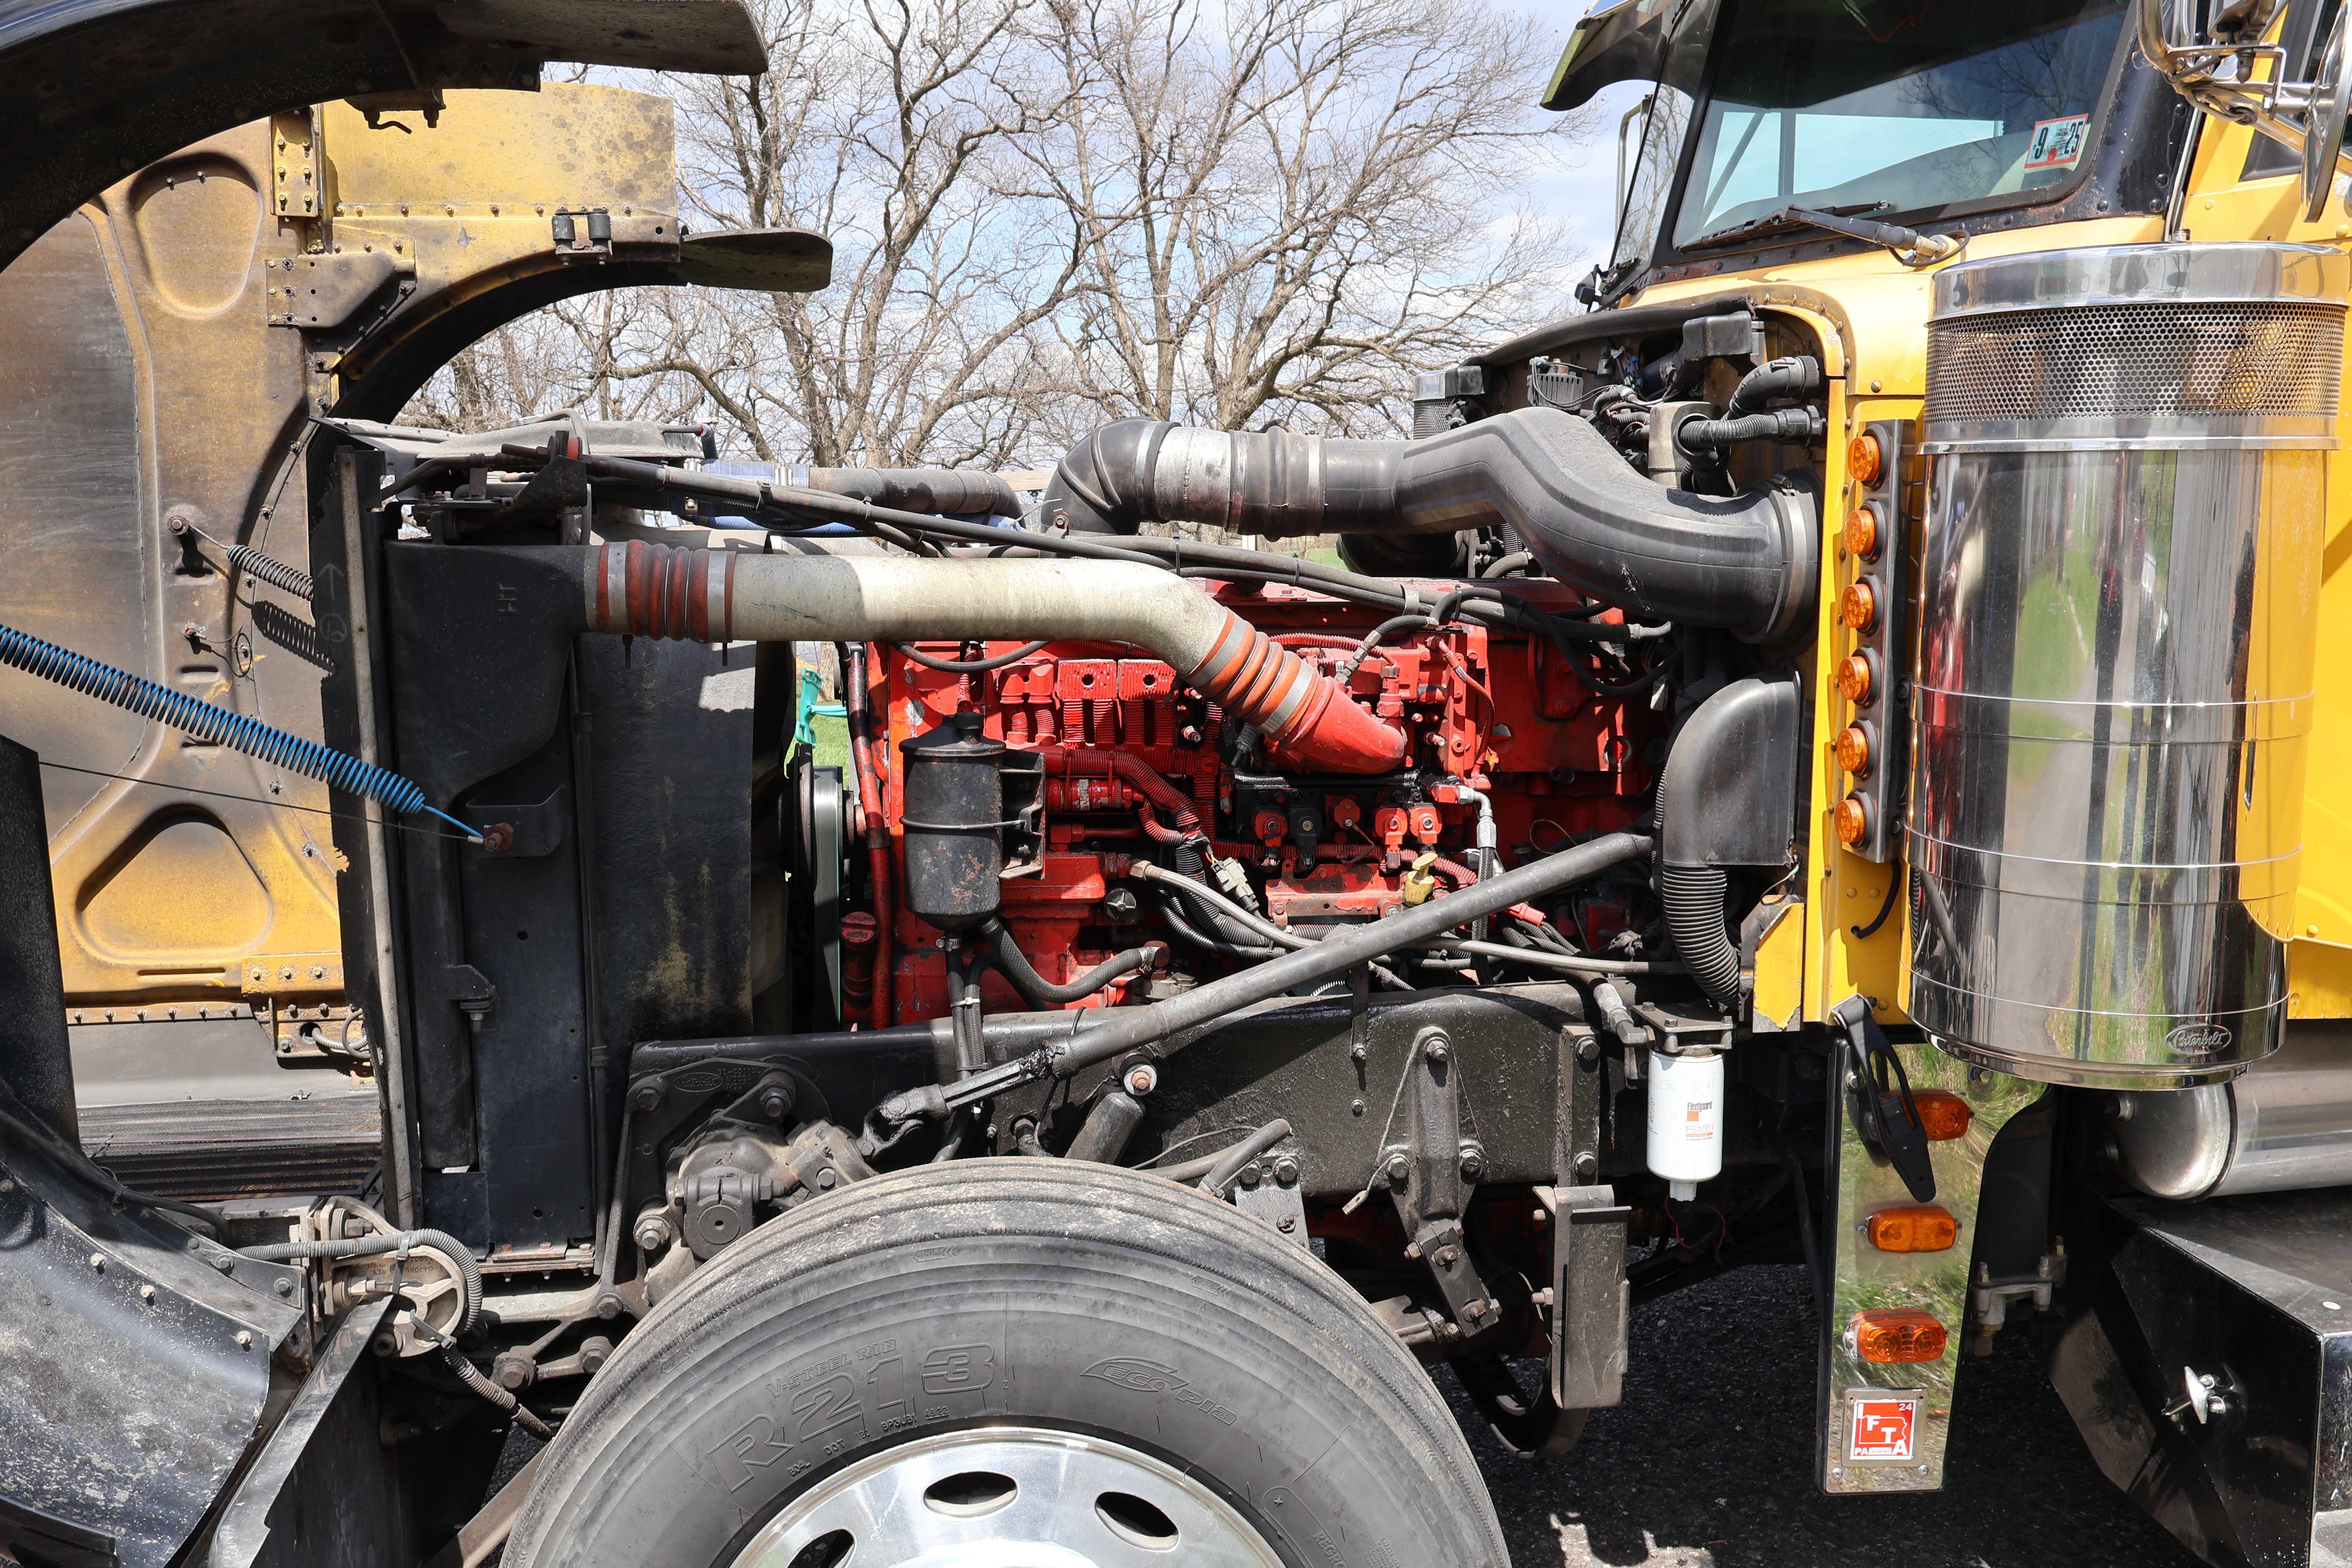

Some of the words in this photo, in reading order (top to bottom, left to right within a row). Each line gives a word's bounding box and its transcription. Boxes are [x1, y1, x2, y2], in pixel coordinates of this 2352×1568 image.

[2034, 127, 2049, 159] 9
[2063, 121, 2084, 154] 25
[1688, 1101, 1712, 1112] Fleetguard
[1686, 1123, 1714, 1134] FS1001
[1193, 1279, 1216, 1290] ROTATION
[857, 1338, 897, 1361] RIB
[1898, 1403, 1913, 1412] 24
[708, 1343, 995, 1494] R213
[823, 1438, 846, 1456] DOT
[937, 1406, 949, 1416] 22
[1854, 1447, 1869, 1455] PA
